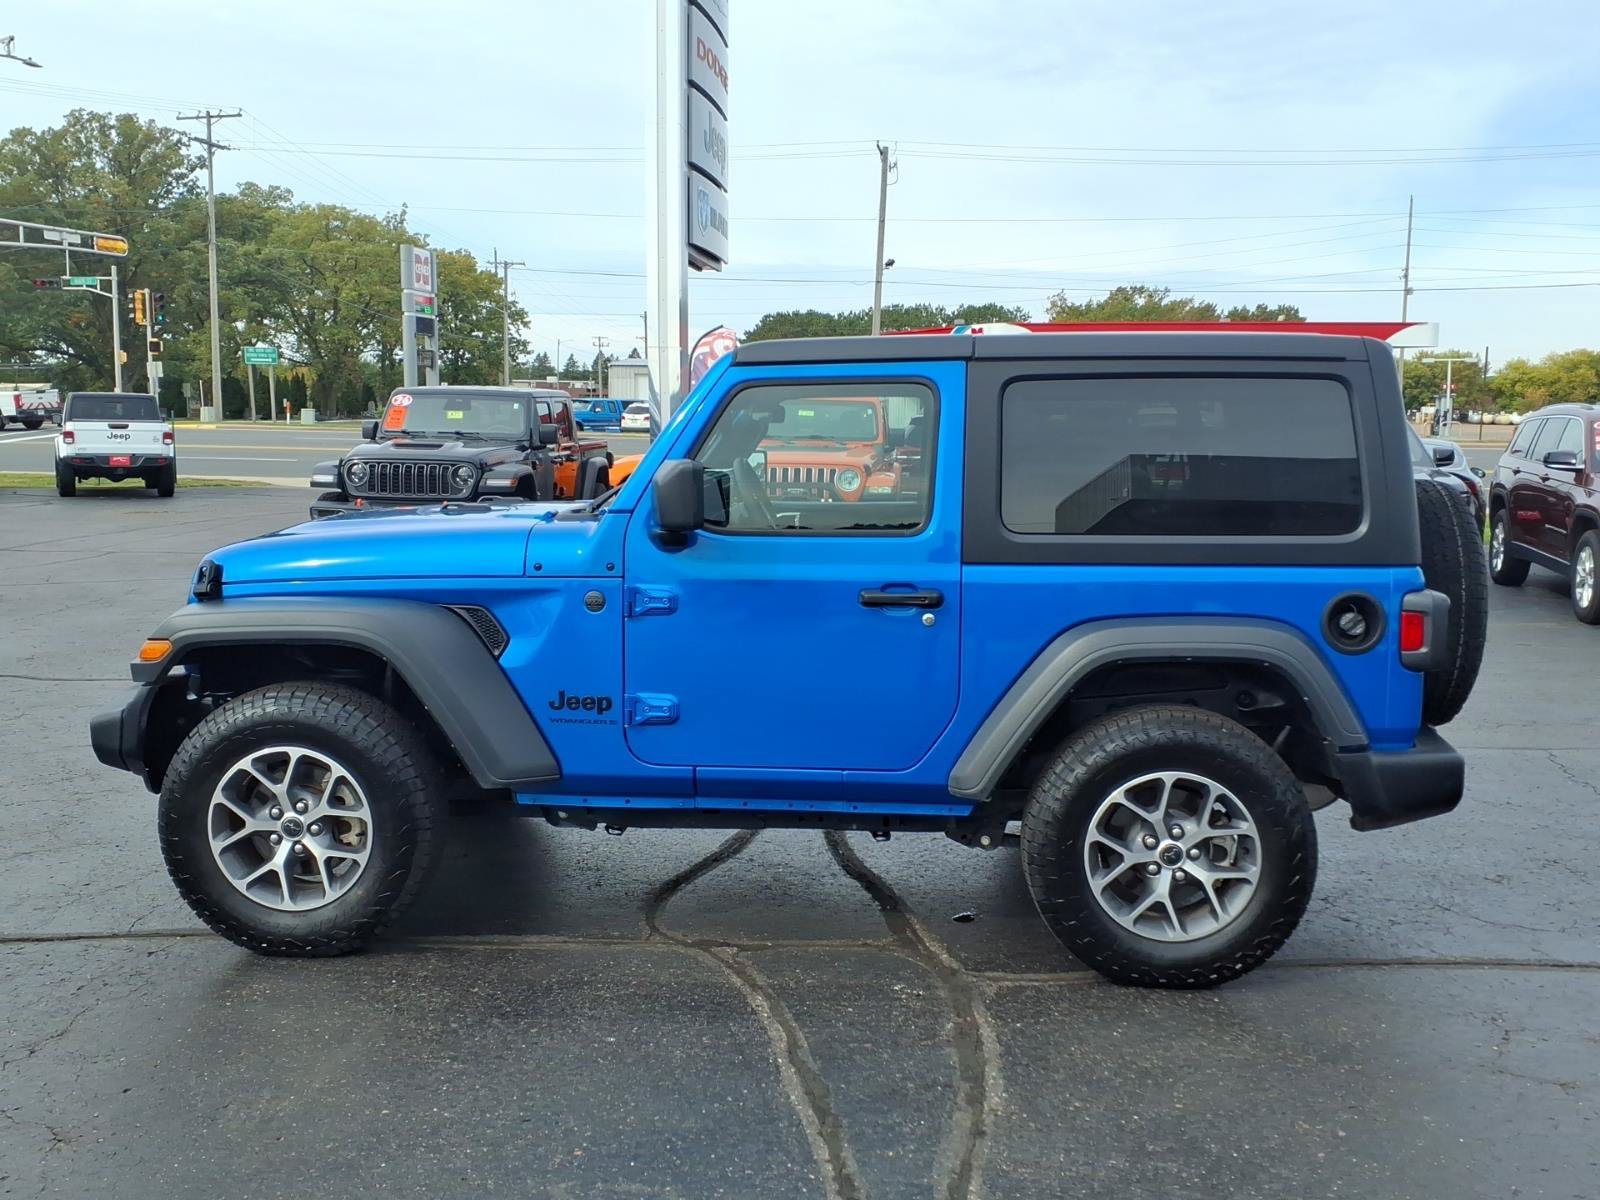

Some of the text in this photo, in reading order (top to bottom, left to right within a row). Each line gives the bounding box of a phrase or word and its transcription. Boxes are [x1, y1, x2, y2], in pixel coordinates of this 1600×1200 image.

[704, 111, 727, 177] Jeep
[106, 431, 131, 441] Jeep
[548, 689, 613, 715] Jeep
